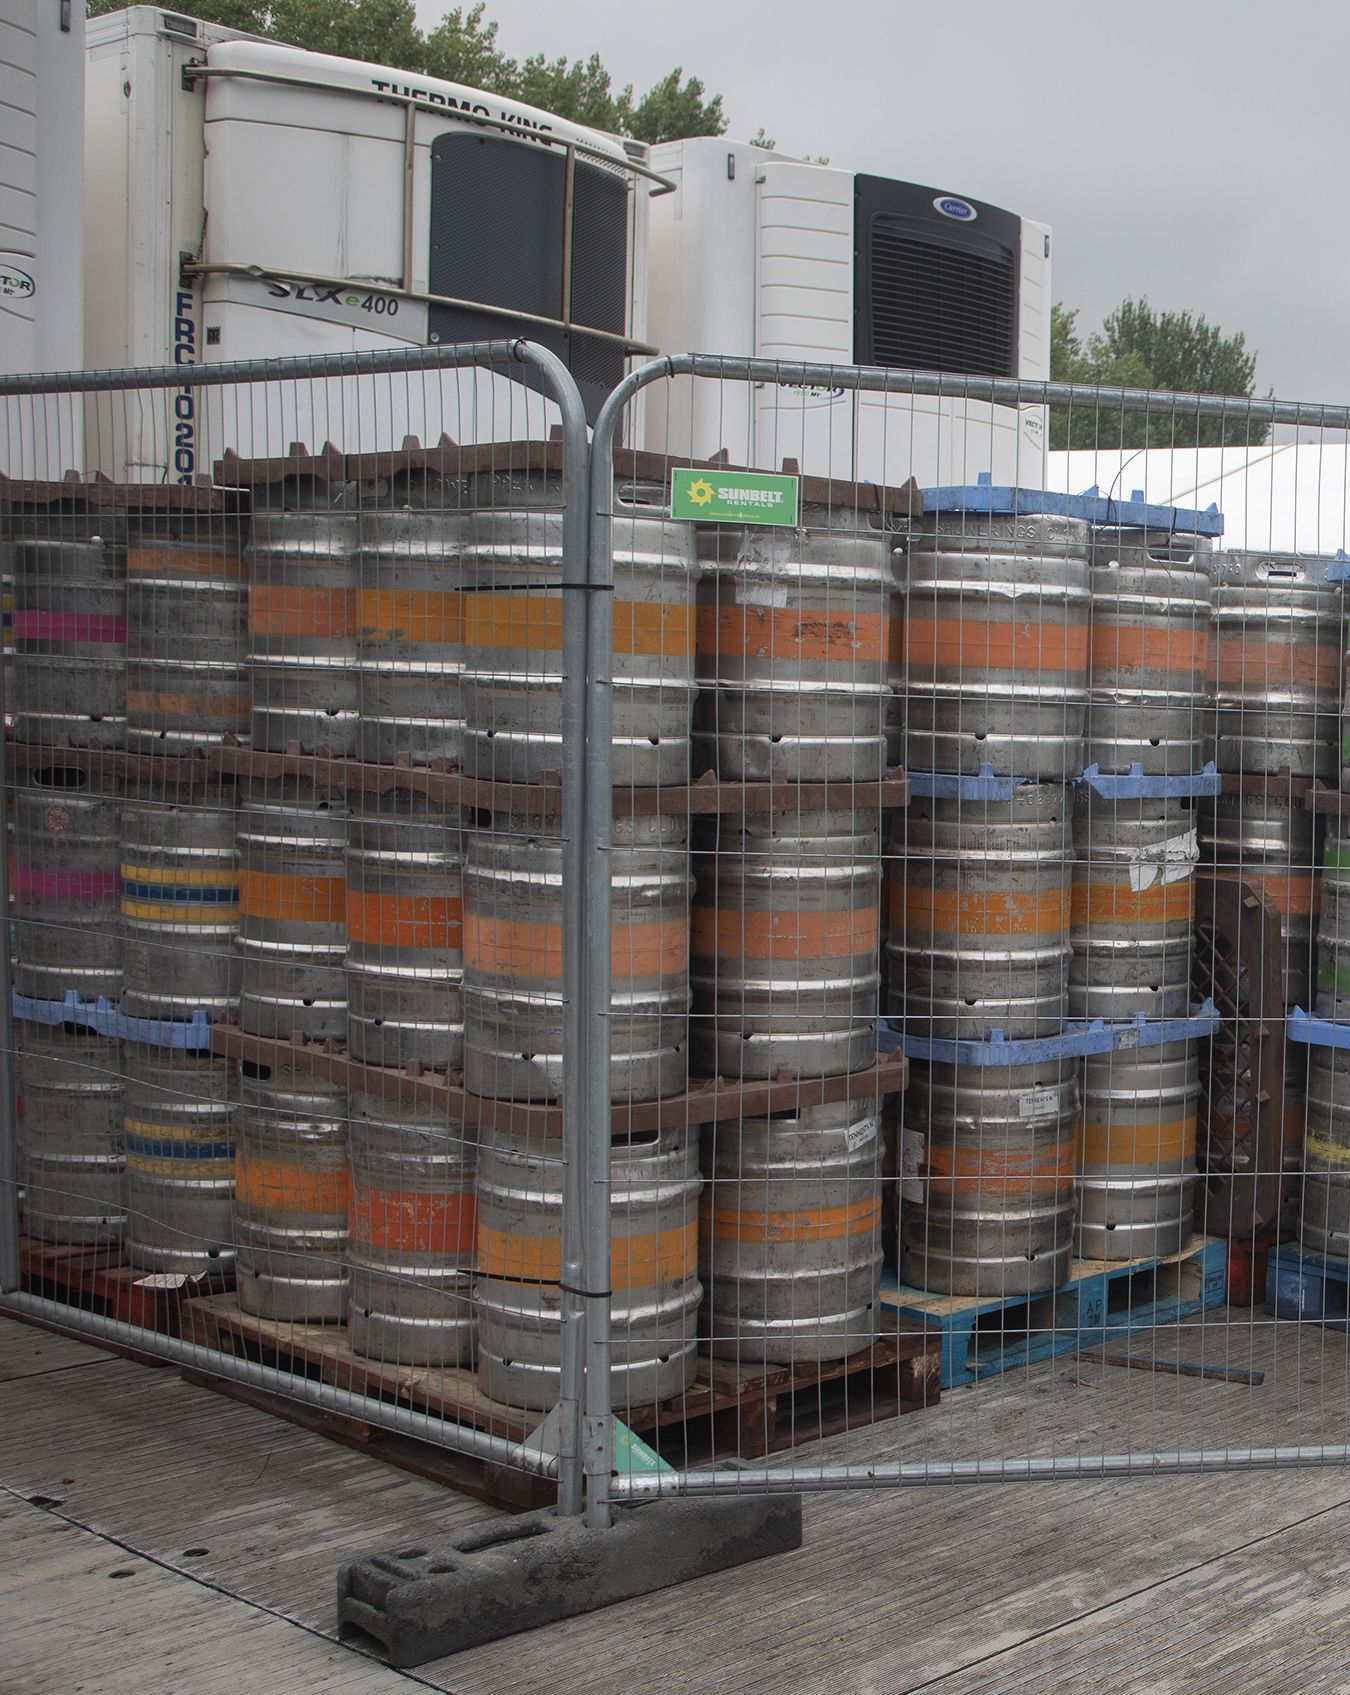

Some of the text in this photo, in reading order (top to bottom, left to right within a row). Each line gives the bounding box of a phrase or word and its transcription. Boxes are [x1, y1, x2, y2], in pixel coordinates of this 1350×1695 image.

[371, 79, 553, 147] THERMO KING
[174, 292, 195, 486] FRC020
[718, 487, 782, 503] SUNBELT
[726, 499, 773, 508] RENTALS
